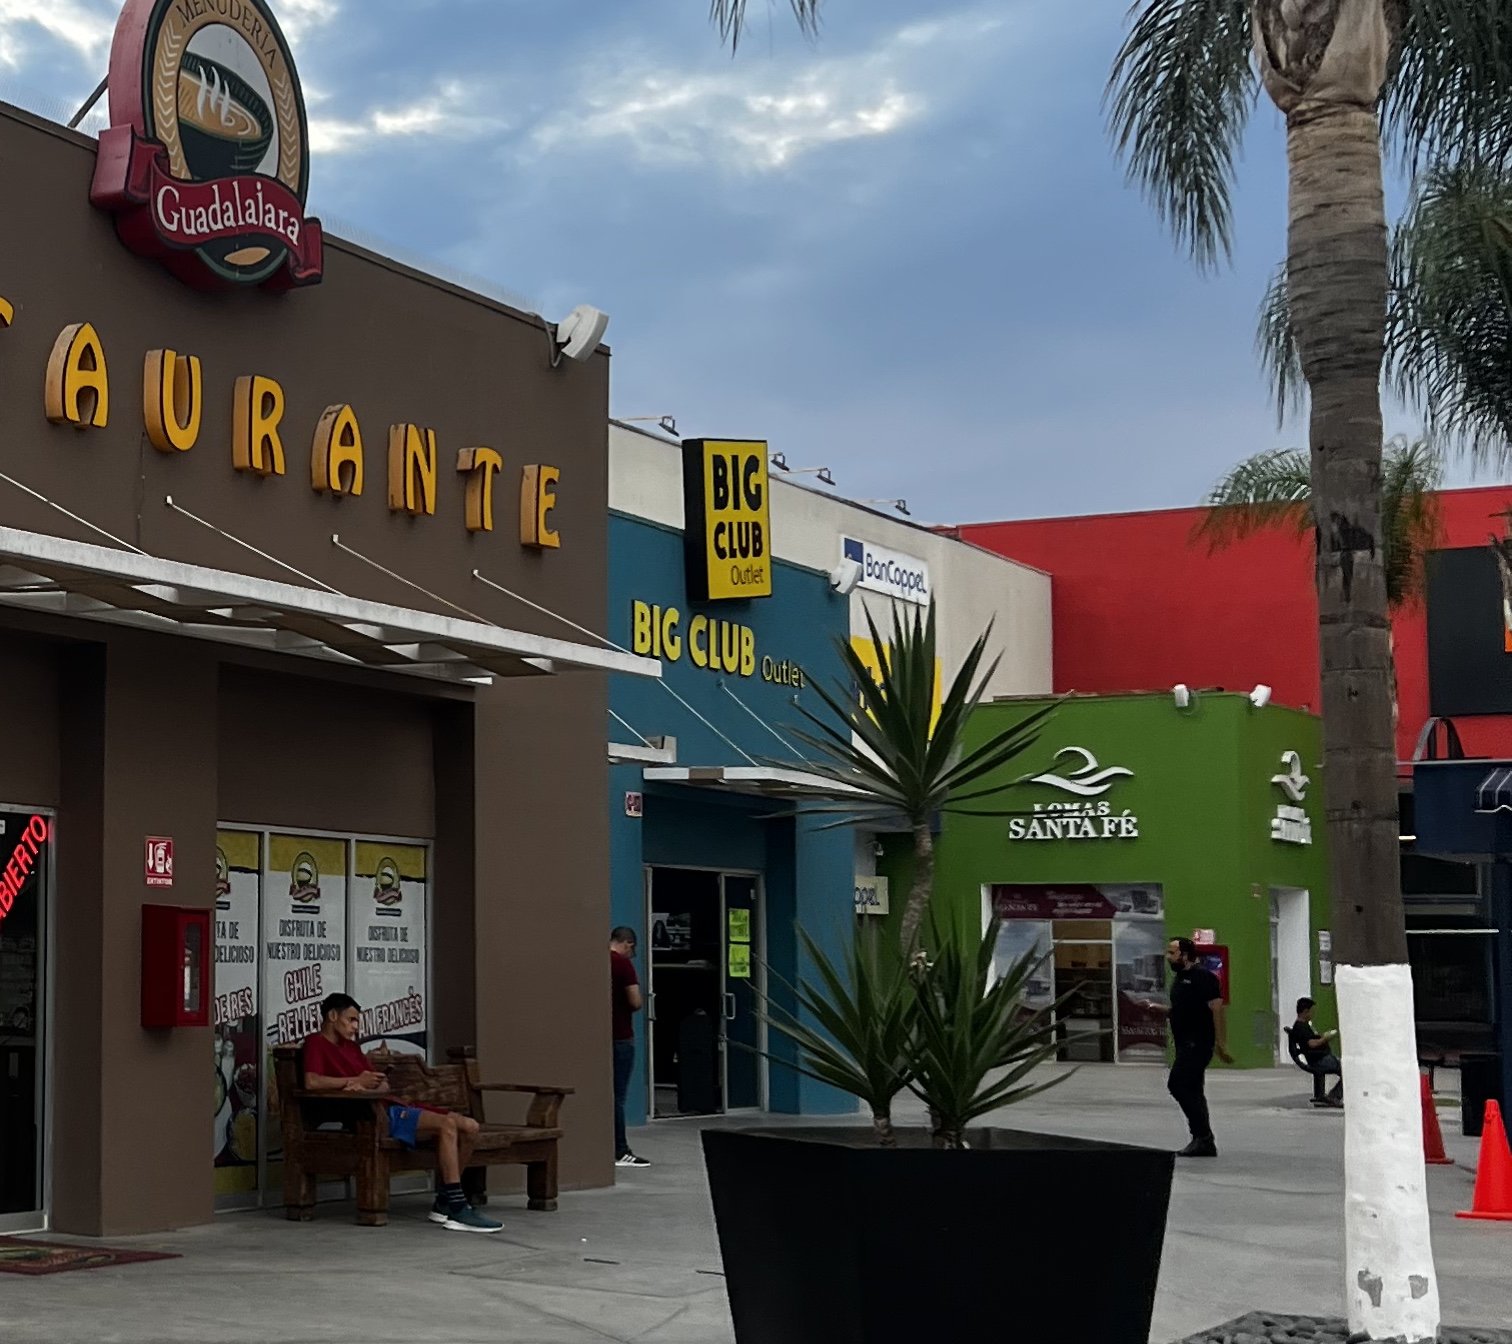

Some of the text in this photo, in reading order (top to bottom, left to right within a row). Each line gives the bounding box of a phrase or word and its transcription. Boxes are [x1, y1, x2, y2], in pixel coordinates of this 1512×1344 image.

[156, 182, 300, 248] Guadalajara
[711, 453, 763, 512] BIG
[712, 520, 764, 560] CLUB
[730, 564, 765, 587] Outlet
[865, 552, 928, 597] BanCoppel
[632, 599, 682, 662] BIG
[688, 614, 756, 677] CLUB
[1008, 808, 1140, 840] SANTA FÉ
[1032, 800, 1112, 818] LOMAS
[279, 919, 328, 939] DISFRUTA DE
[267, 941, 342, 962] NUESTRO DELICIOSO
[284, 962, 323, 1005] CHILE
[277, 1001, 324, 1045] RELLEN
